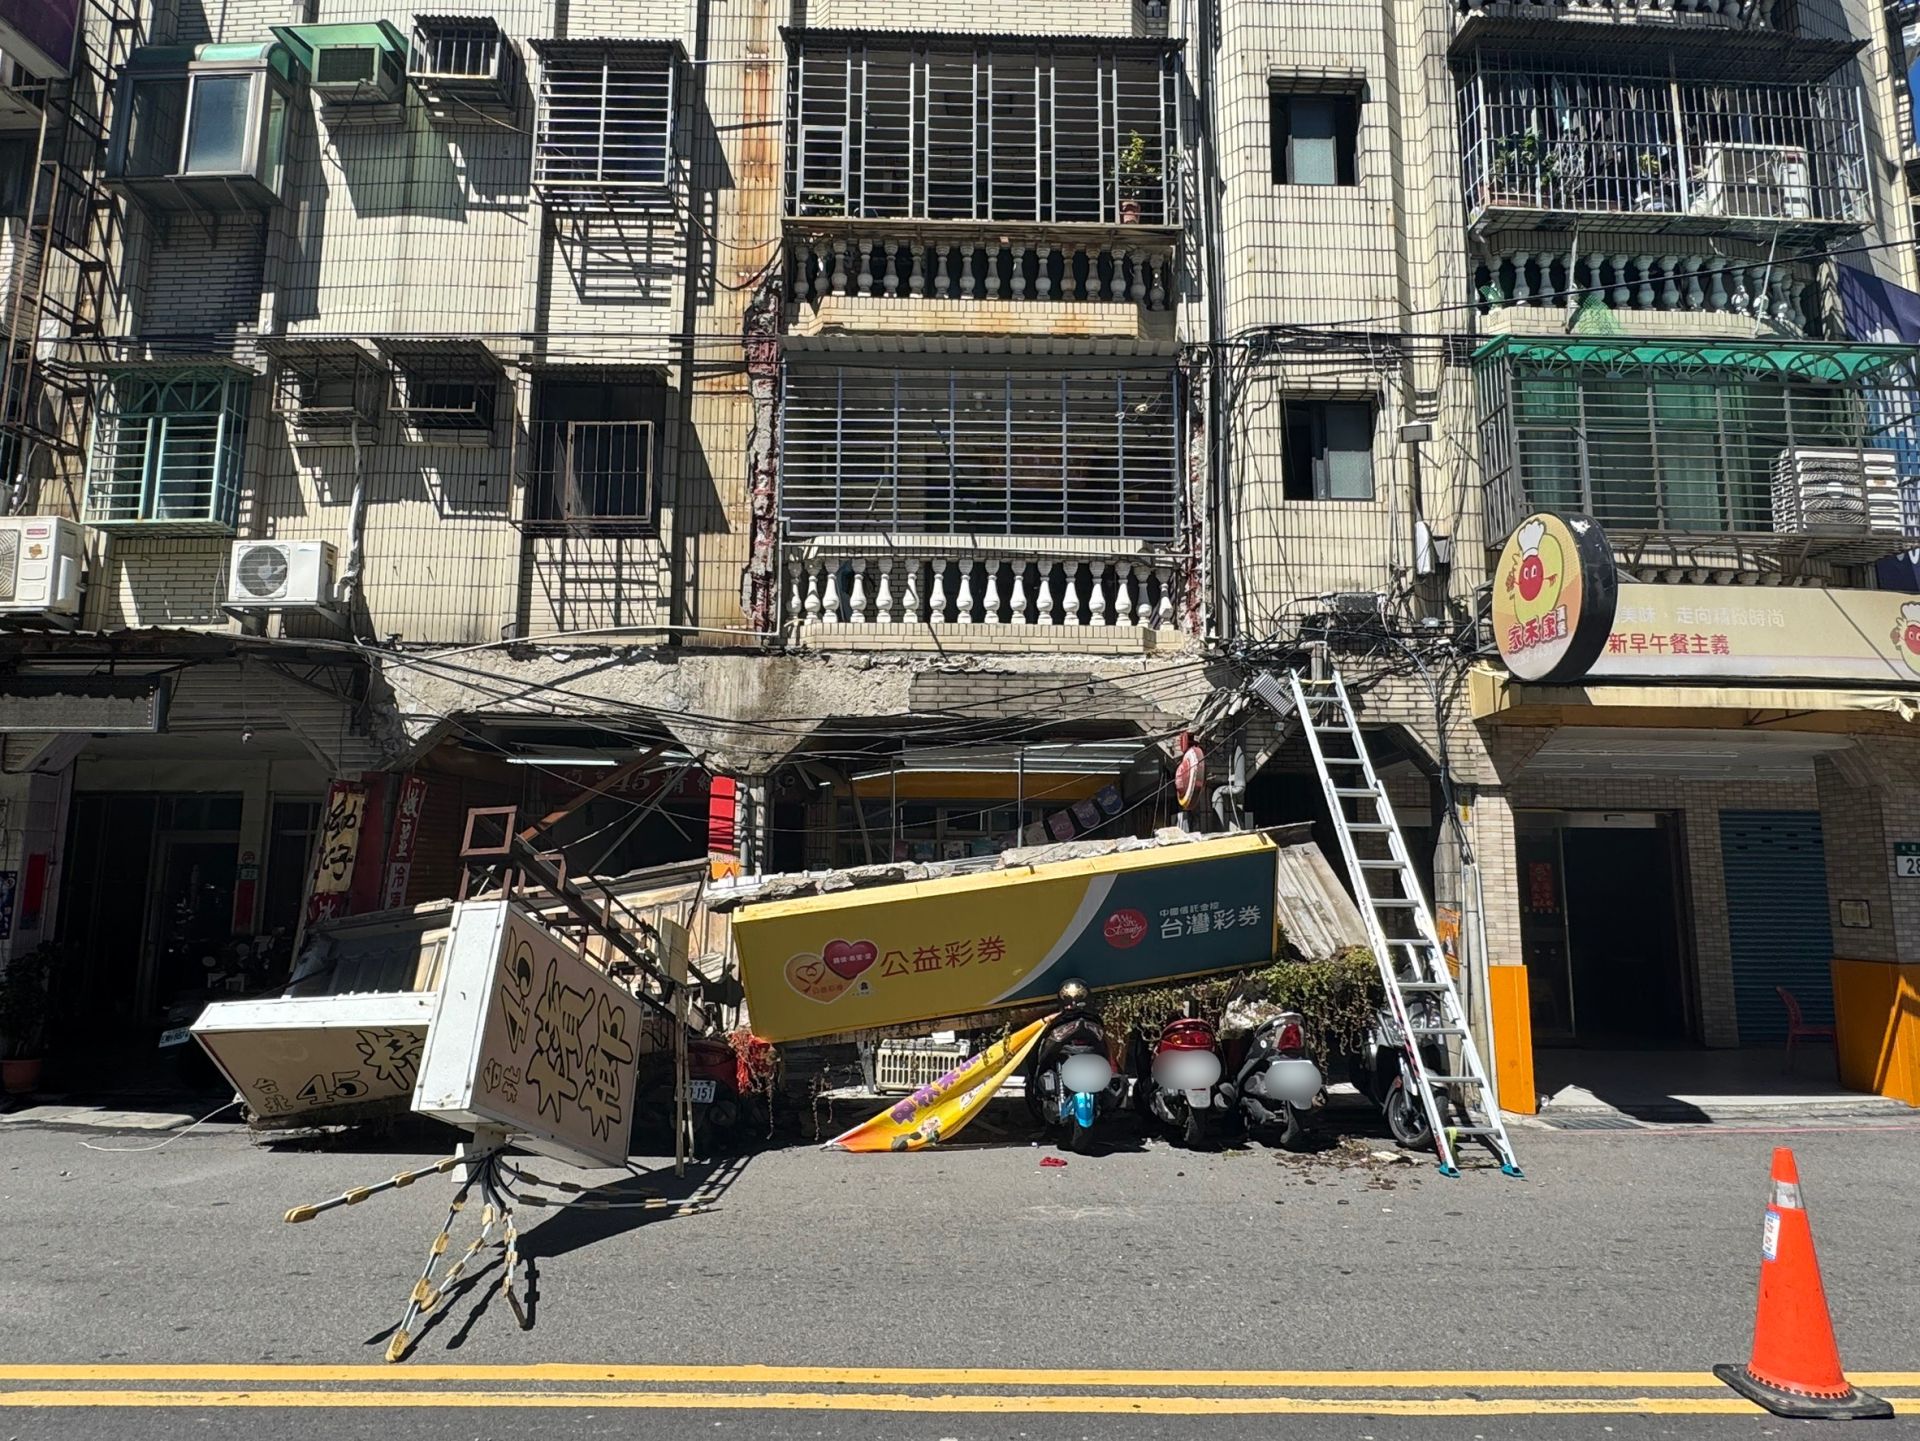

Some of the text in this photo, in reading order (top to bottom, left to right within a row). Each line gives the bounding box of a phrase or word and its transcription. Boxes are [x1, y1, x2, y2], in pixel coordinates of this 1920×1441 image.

[1608, 633, 1730, 655] 新早午餐主義
[1159, 902, 1219, 917] 中國信託金控
[1160, 905, 1261, 939] 台灣彩券
[880, 935, 1007, 978] 公益彩券
[501, 926, 535, 1053] 45
